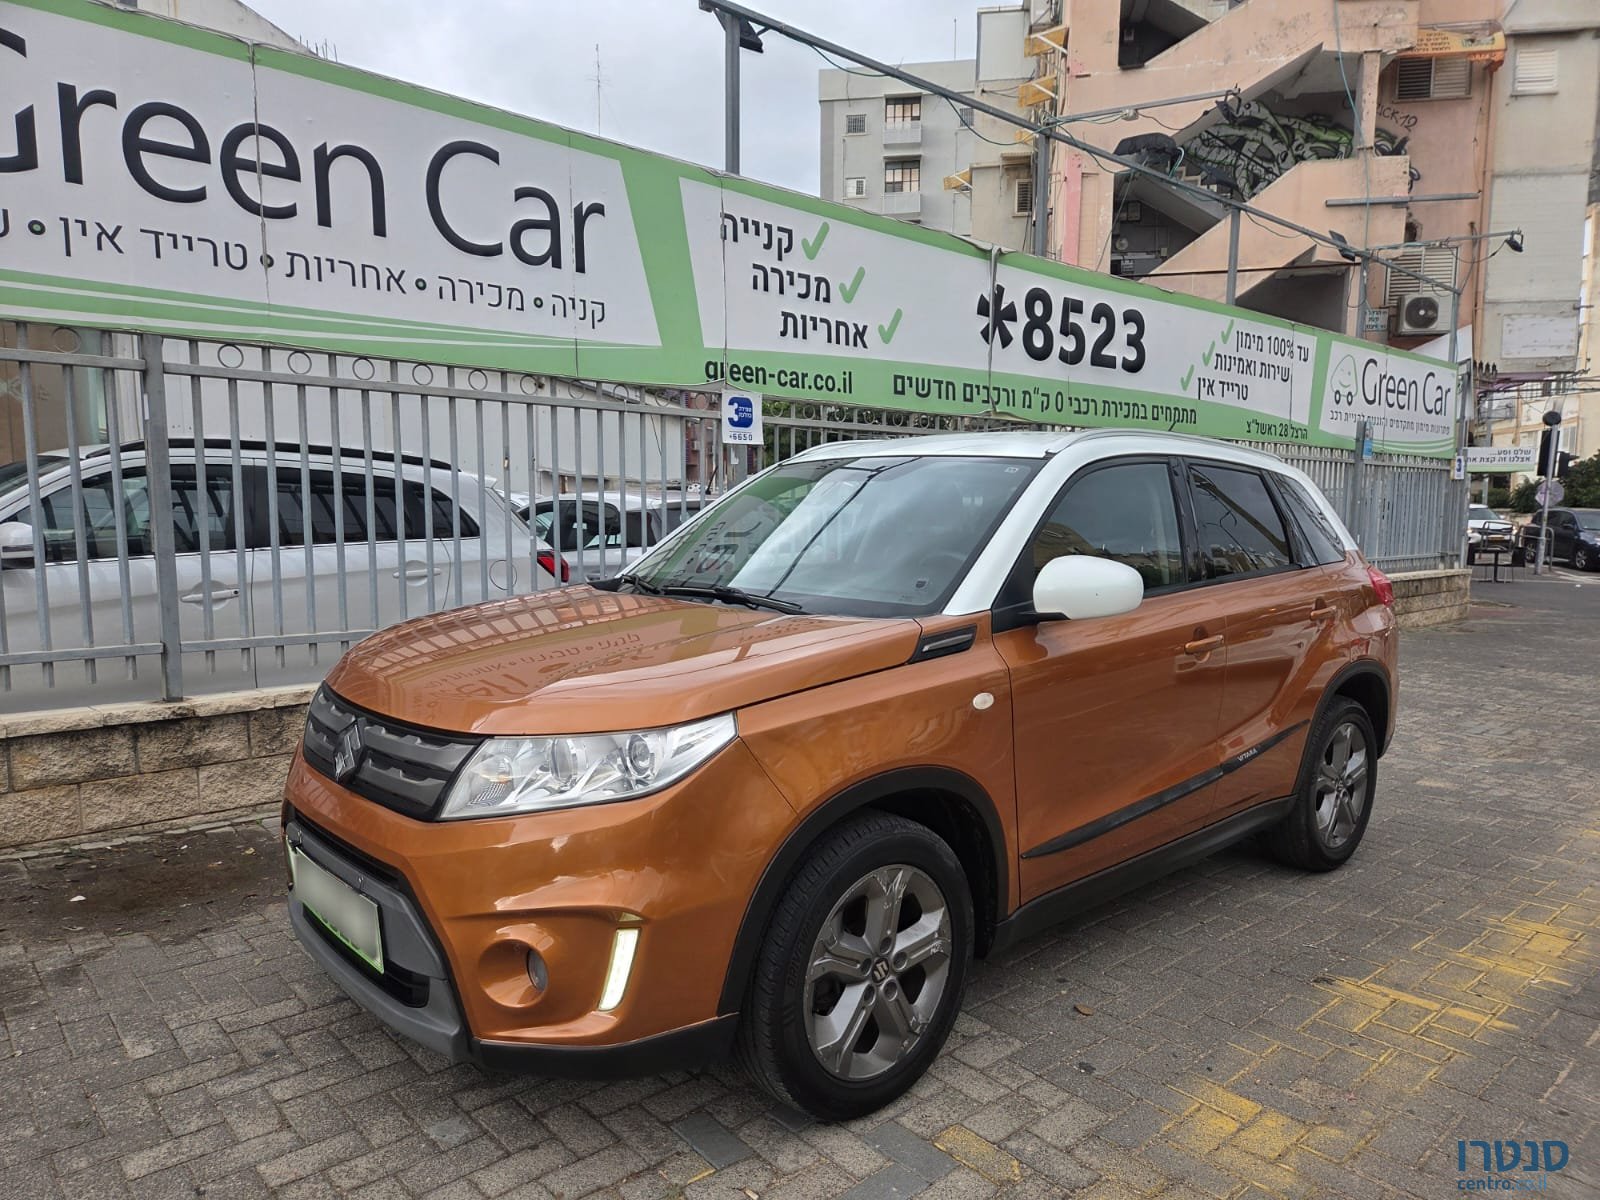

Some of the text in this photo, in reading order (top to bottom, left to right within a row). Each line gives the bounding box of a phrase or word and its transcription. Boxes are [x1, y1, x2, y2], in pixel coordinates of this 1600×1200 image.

[426, 140, 605, 274] Car
[59, 216, 124, 257] אין
[140, 227, 248, 271] טרייד
[720, 212, 794, 261] קנייה
[285, 251, 407, 294] אחריות
[752, 263, 831, 303] מכירה
[438, 275, 525, 312] מכירה
[552, 293, 606, 329] קניה
[780, 311, 869, 349] אחריות
[1236, 330, 1309, 362] עד 100% מימון
[704, 359, 853, 395] green-car.co.il
[1214, 353, 1290, 382] שירות ואמינות
[893, 374, 956, 401] חדשים
[963, 382, 1016, 408] ורכבים
[1197, 377, 1248, 401] טרייד אין
[1362, 358, 1451, 417] Green Car
[1067, 396, 1098, 417] רכבי
[1101, 400, 1148, 420] במכירת
[1152, 405, 1197, 425] מתמחים
[1278, 423, 1289, 438] 28
